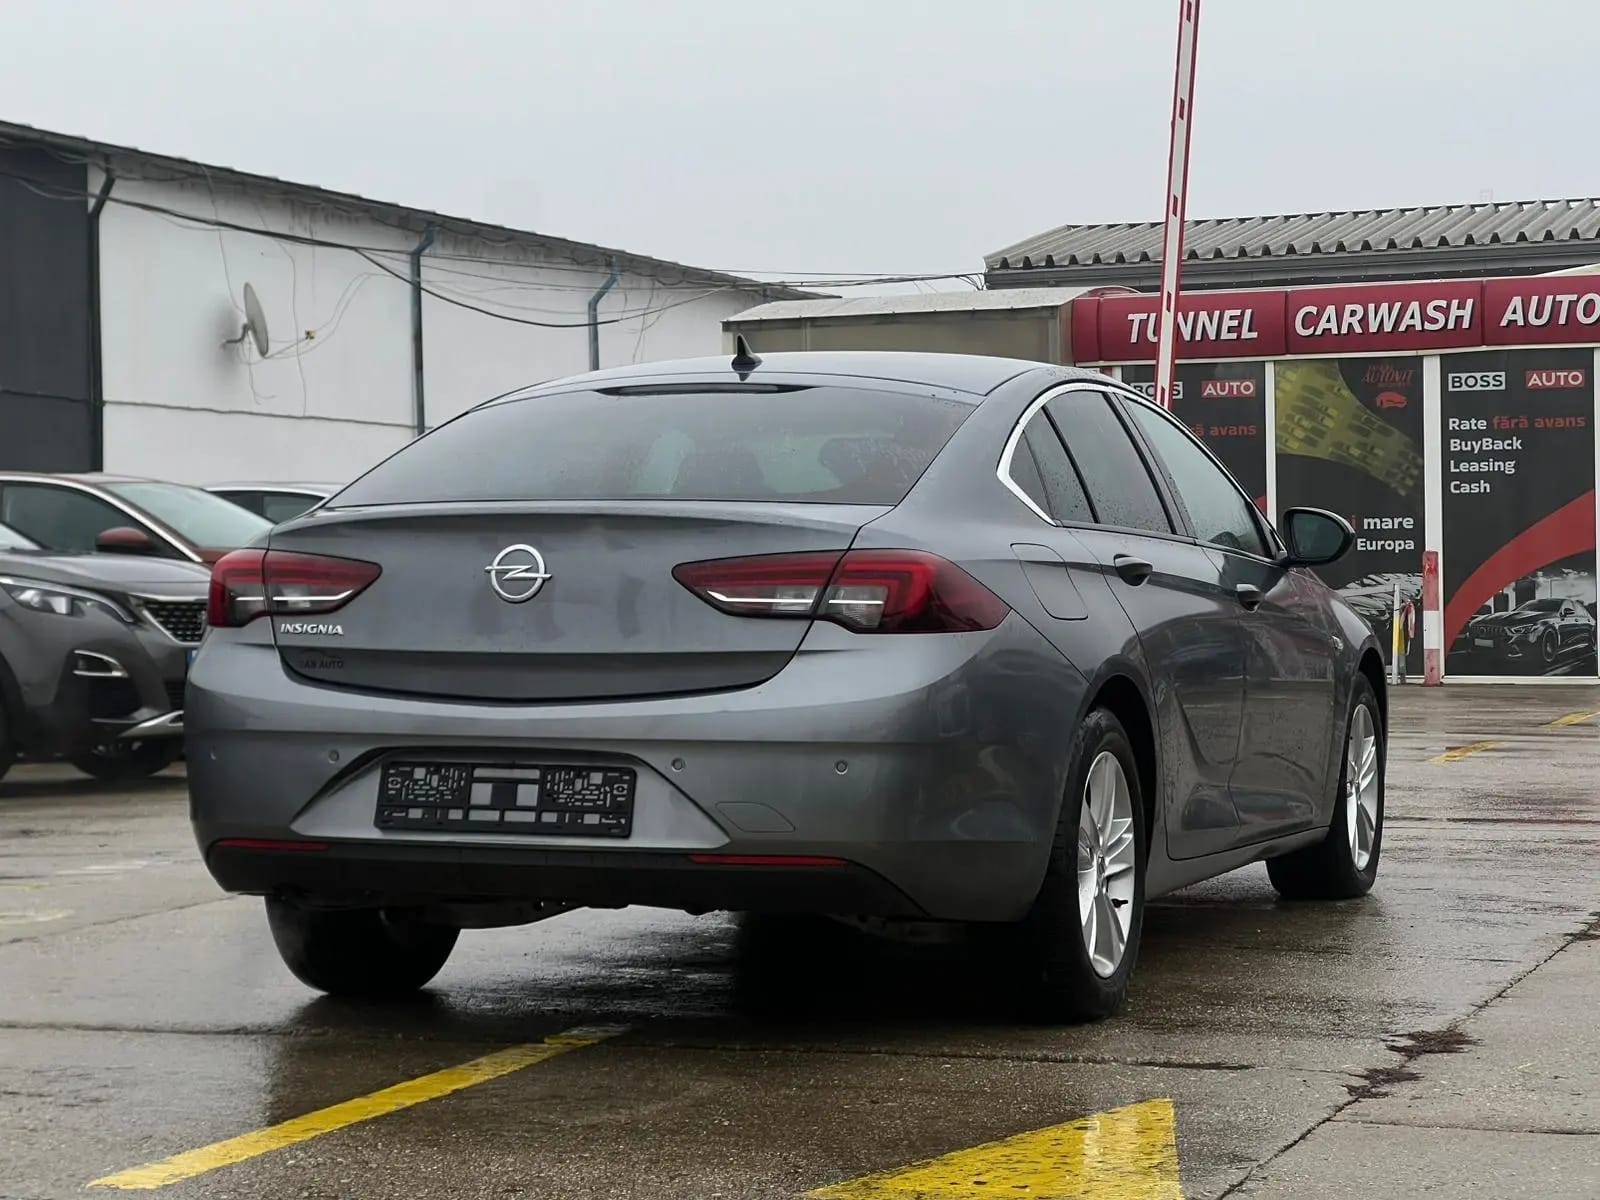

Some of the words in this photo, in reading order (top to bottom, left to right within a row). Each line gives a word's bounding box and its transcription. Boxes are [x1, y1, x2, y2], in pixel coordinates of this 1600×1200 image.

[1127, 309, 1258, 343] TUNNEL
[1295, 299, 1474, 336] CARWASH
[1500, 293, 1600, 326] AUTO
[1451, 374, 1503, 389] BOSS
[1528, 371, 1583, 387] AUTO
[1203, 381, 1254, 396] AUTO
[1210, 425, 1256, 437] avans
[1448, 418, 1487, 430] Rate
[1535, 417, 1585, 428] avans
[1450, 436, 1522, 454] BuyBack
[1450, 458, 1516, 474] Leasing
[1450, 480, 1490, 493] Cash
[1363, 517, 1414, 530] mare
[1357, 538, 1415, 553] Europa
[280, 623, 344, 635] INSIGNIA
